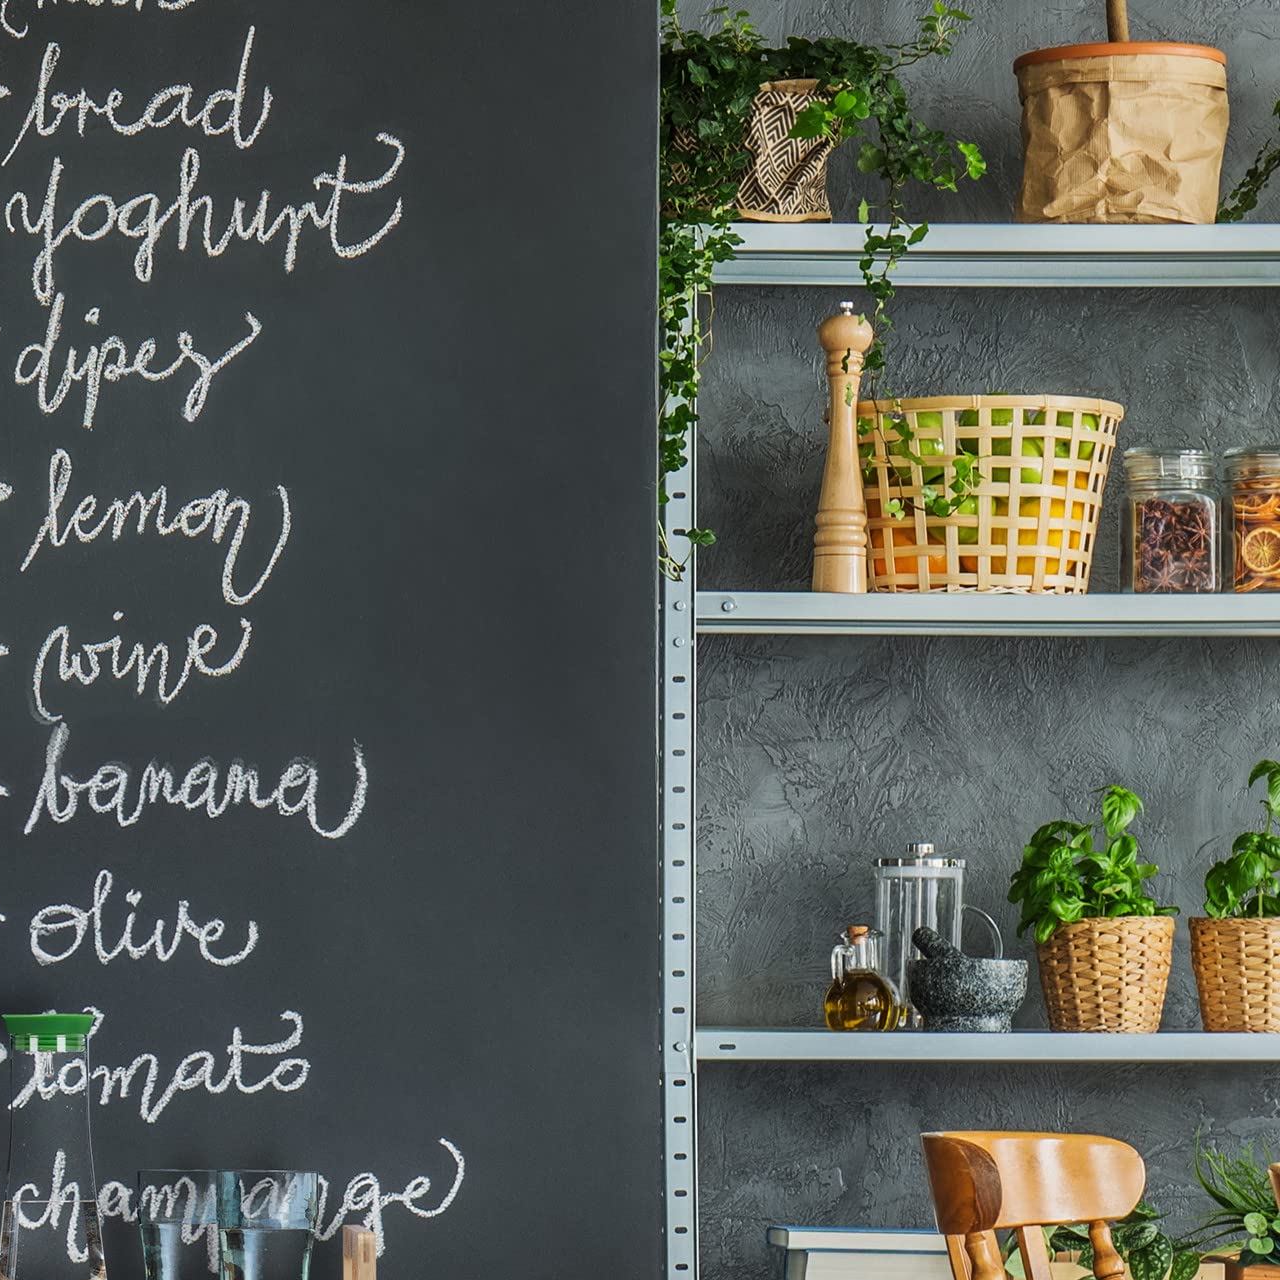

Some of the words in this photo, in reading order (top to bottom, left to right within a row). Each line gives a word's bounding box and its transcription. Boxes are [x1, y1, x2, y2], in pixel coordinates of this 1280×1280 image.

[2, 25, 273, 167] bread
[5, 132, 405, 306] yoghurt
[20, 448, 291, 605] lemon
[32, 611, 253, 722] wine
[23, 721, 368, 839] banana
[29, 869, 259, 966] olive
